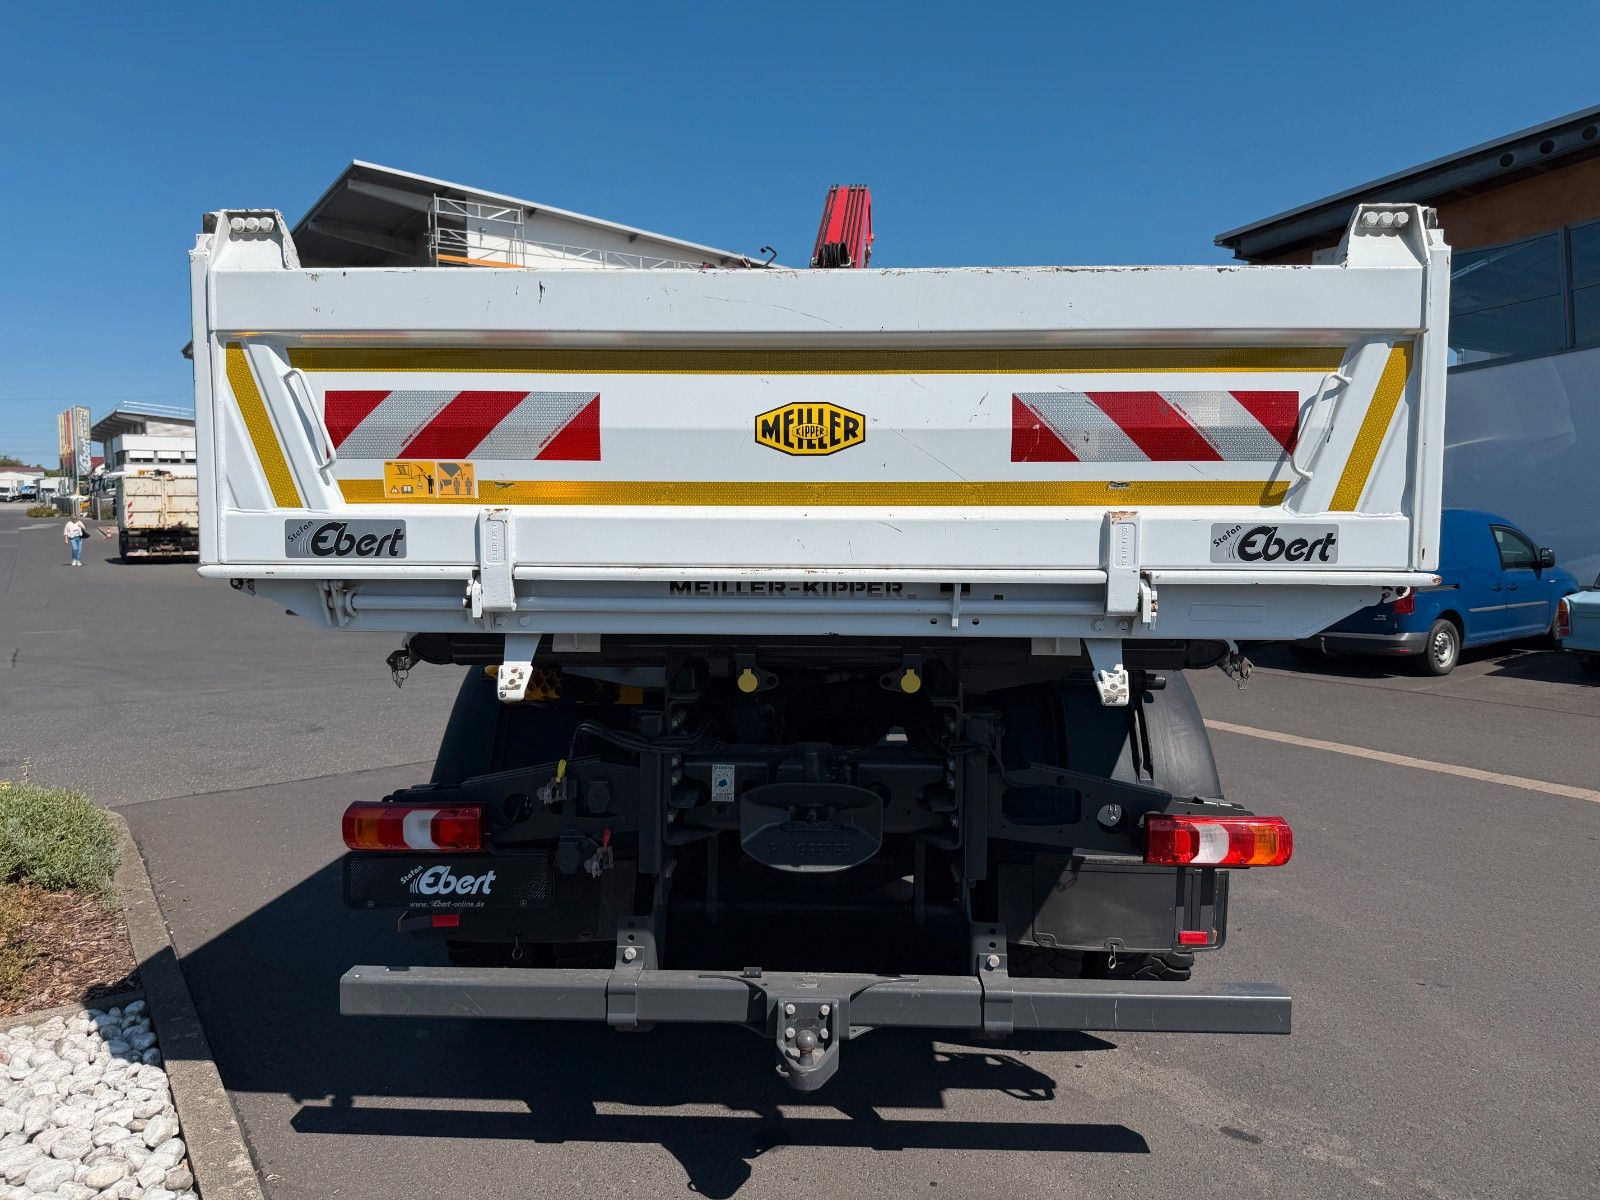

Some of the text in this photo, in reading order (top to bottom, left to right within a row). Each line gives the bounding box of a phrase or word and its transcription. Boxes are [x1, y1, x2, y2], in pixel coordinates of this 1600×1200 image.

[762, 408, 859, 449] MEILLER
[796, 425, 824, 437] KIPPER
[287, 520, 403, 556] Stefan Ebert
[1212, 524, 1336, 561] Stefan Ebert
[669, 580, 904, 597] MEILLER-KIPPER
[400, 865, 496, 894] Stefan Ebert
